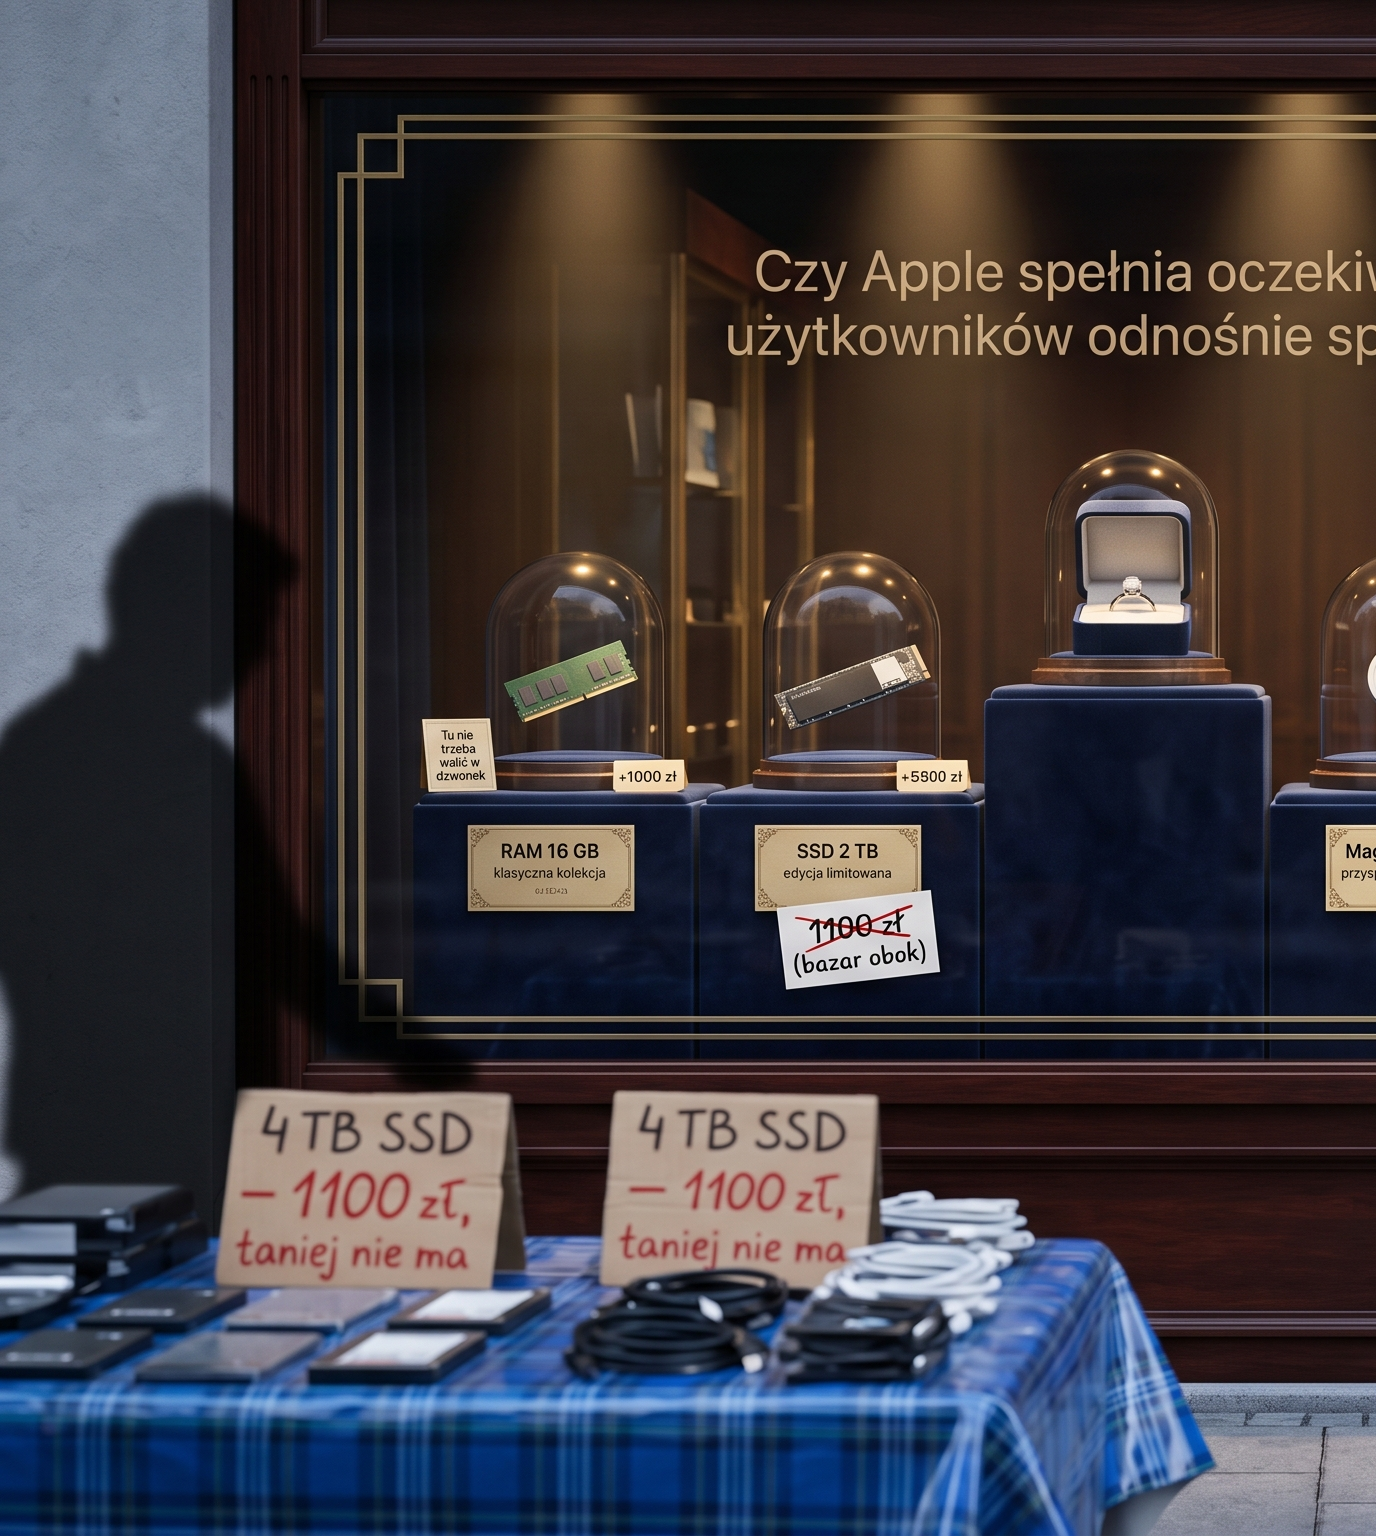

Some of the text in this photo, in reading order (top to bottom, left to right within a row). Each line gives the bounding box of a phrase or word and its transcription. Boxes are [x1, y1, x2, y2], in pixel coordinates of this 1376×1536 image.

[755, 249, 848, 302] Czy
[861, 249, 1004, 302] Apple
[1019, 249, 1192, 302] spełnia
[727, 311, 1074, 366] użytkowników
[1088, 311, 1313, 357] odnośnie
[441, 729, 474, 741] Tu nie
[440, 743, 476, 754] trzeba
[436, 769, 486, 781] dzwonek
[470, 759, 481, 768] w
[619, 770, 677, 783] +1000 zł
[950, 770, 963, 783] zł
[501, 842, 599, 859] RAM 16 GB
[797, 842, 879, 859] SSD 2 TB
[494, 866, 606, 882] klasyczna kolekcja
[783, 867, 892, 882] edycja limitowana
[808, 913, 873, 944] 1100
[793, 935, 926, 979] (bazar obok)
[261, 1105, 473, 1156] 4 TB SSD
[638, 1105, 847, 1153] 4 TB SSD
[293, 1170, 411, 1220] 1100
[685, 1169, 787, 1213] 1100
[236, 1230, 468, 1282] taniej nie ma
[619, 1224, 846, 1268] taniej nie ma
